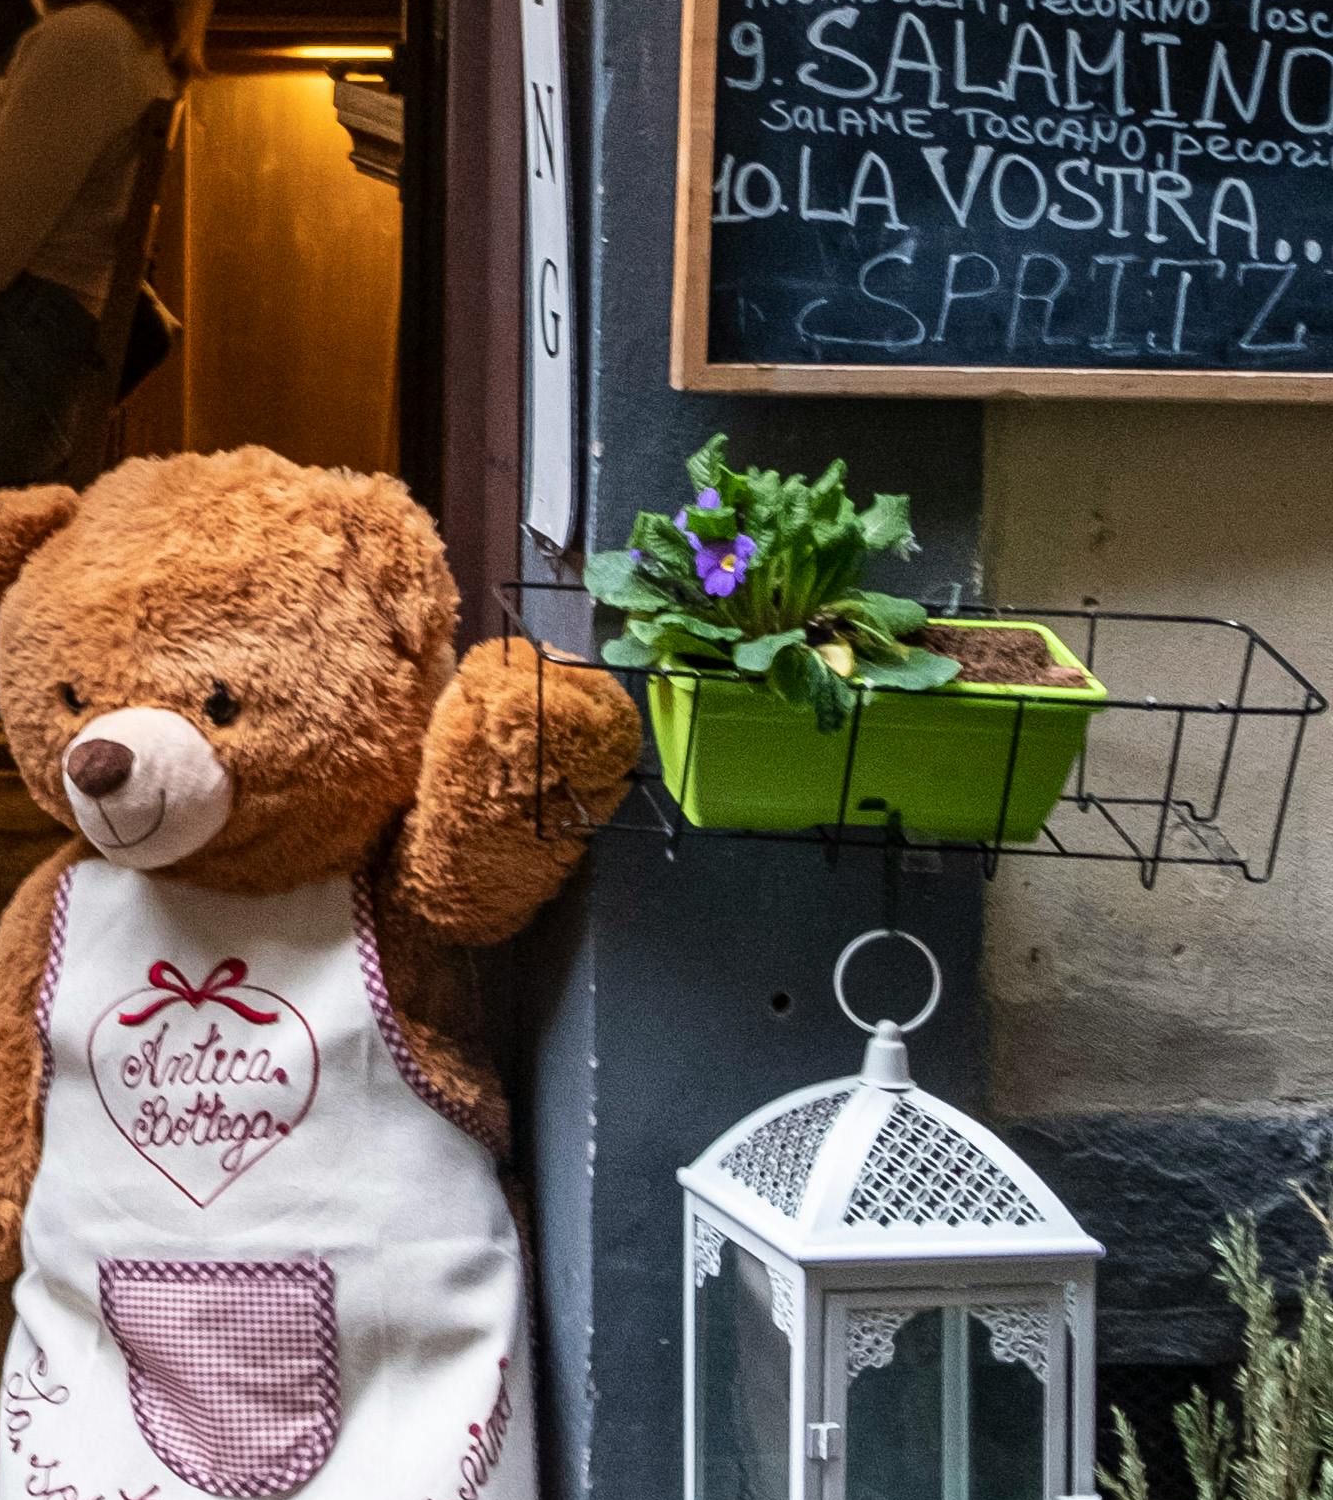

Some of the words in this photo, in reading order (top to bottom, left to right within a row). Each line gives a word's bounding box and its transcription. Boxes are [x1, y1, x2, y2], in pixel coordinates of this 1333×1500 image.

[796, 5, 1333, 136] SALAMINO
[797, 143, 912, 232] LA
[1170, 129, 1333, 185] pecori
[796, 238, 1309, 356] SPRITZ
[120, 1022, 289, 1090] Antica
[133, 1090, 291, 1173] Bottega
